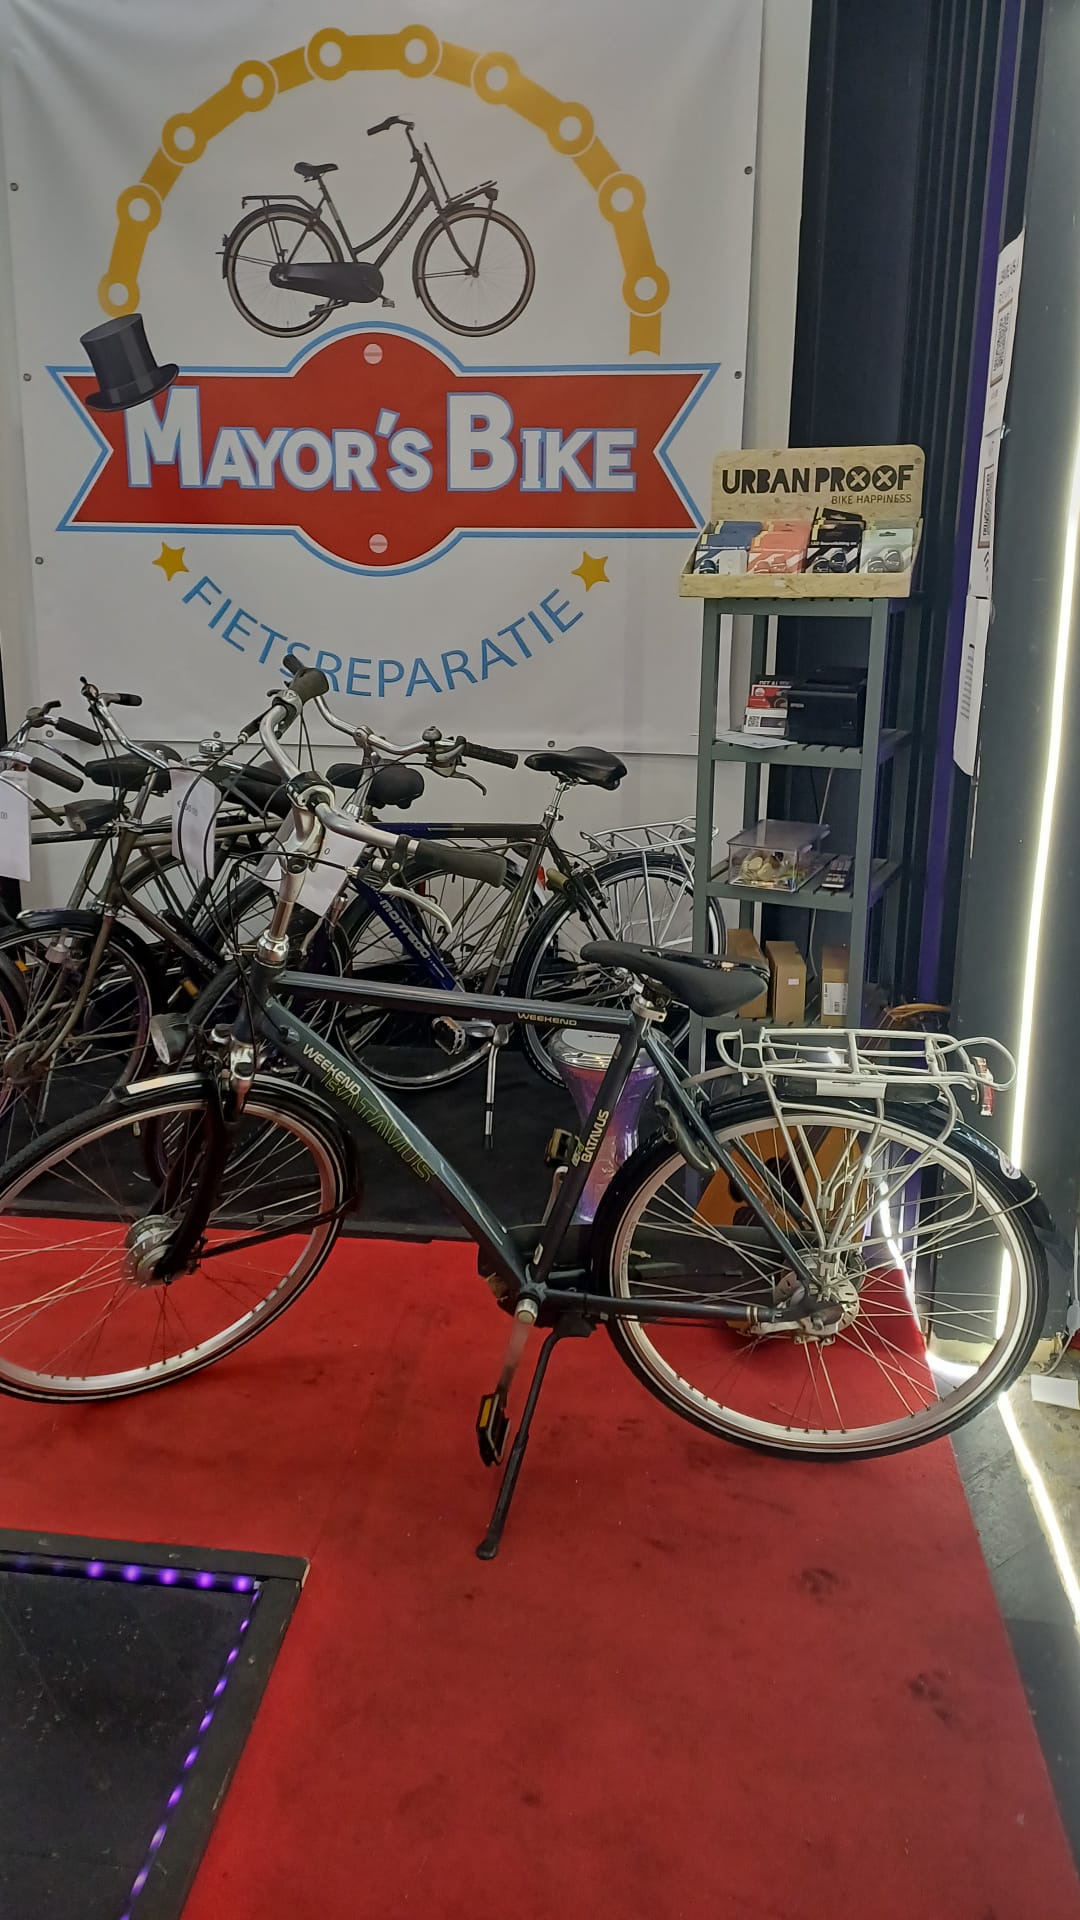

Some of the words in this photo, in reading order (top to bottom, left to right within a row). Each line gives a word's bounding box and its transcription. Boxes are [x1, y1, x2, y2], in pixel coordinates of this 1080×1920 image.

[125, 385, 432, 491] MAYOR'S
[446, 391, 639, 493] BIKE
[831, 496, 853, 505] BIKE
[856, 494, 912, 504] HAPPINESS
[517, 1011, 577, 1026] WEEKEND
[303, 1043, 362, 1096] WEEKEND
[581, 1108, 610, 1163] BATAVUS
